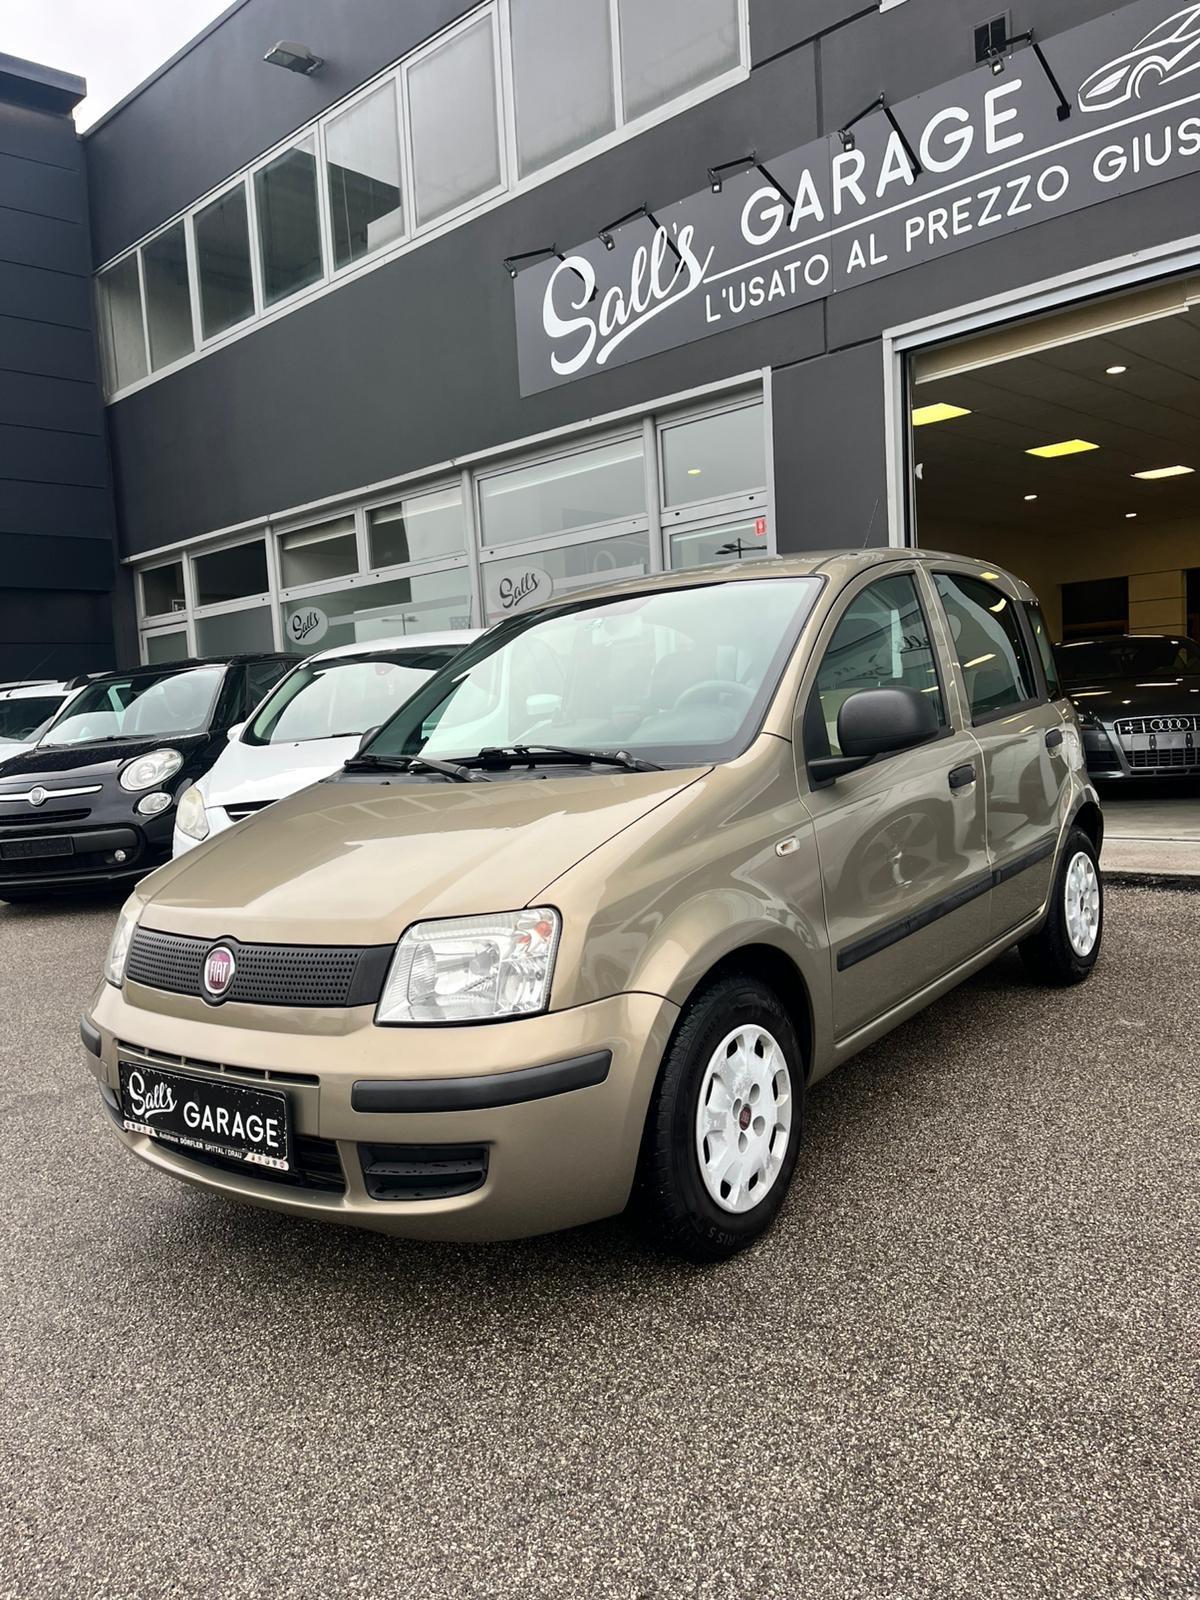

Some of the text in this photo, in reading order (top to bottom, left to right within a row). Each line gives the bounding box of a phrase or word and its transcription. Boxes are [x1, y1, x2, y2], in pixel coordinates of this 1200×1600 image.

[740, 79, 1024, 246] GARAGE
[705, 117, 1200, 323] L'USATO AL PREZZO GIUS
[209, 958, 228, 982] FIAT
[184, 1101, 279, 1147] GARAGE
